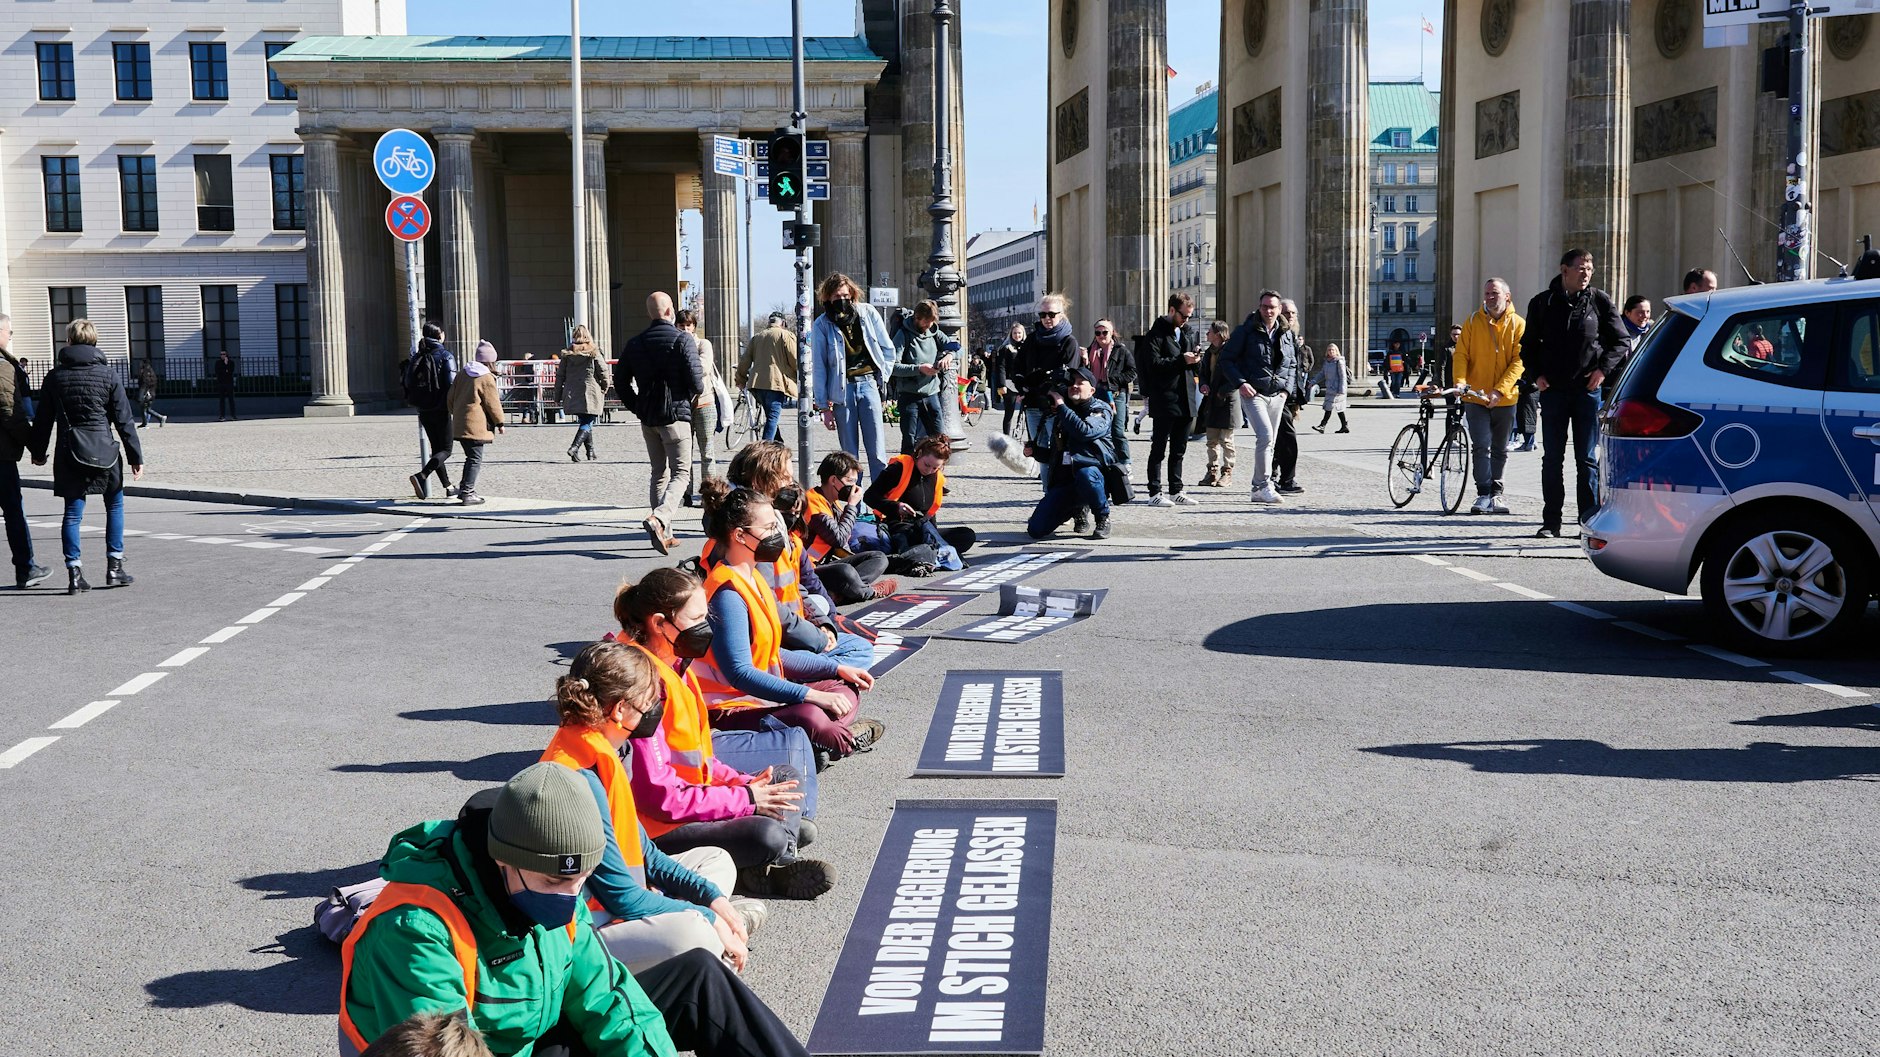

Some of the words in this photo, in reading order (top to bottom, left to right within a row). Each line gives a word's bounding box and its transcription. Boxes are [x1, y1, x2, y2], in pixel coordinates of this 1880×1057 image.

[954, 683, 995, 724] REGIERUNG
[998, 677, 1043, 720] GELASSEN
[944, 742, 984, 762] VON
[949, 724, 988, 742] DER
[993, 721, 1041, 754] STICH
[992, 755, 1040, 772] IM
[889, 828, 960, 919] REGIERUNG
[956, 816, 1028, 912] GELASSEN
[875, 922, 937, 962] DER
[938, 916, 1016, 995] STICH
[858, 966, 926, 1016] VON
[928, 1002, 1006, 1042] IM
